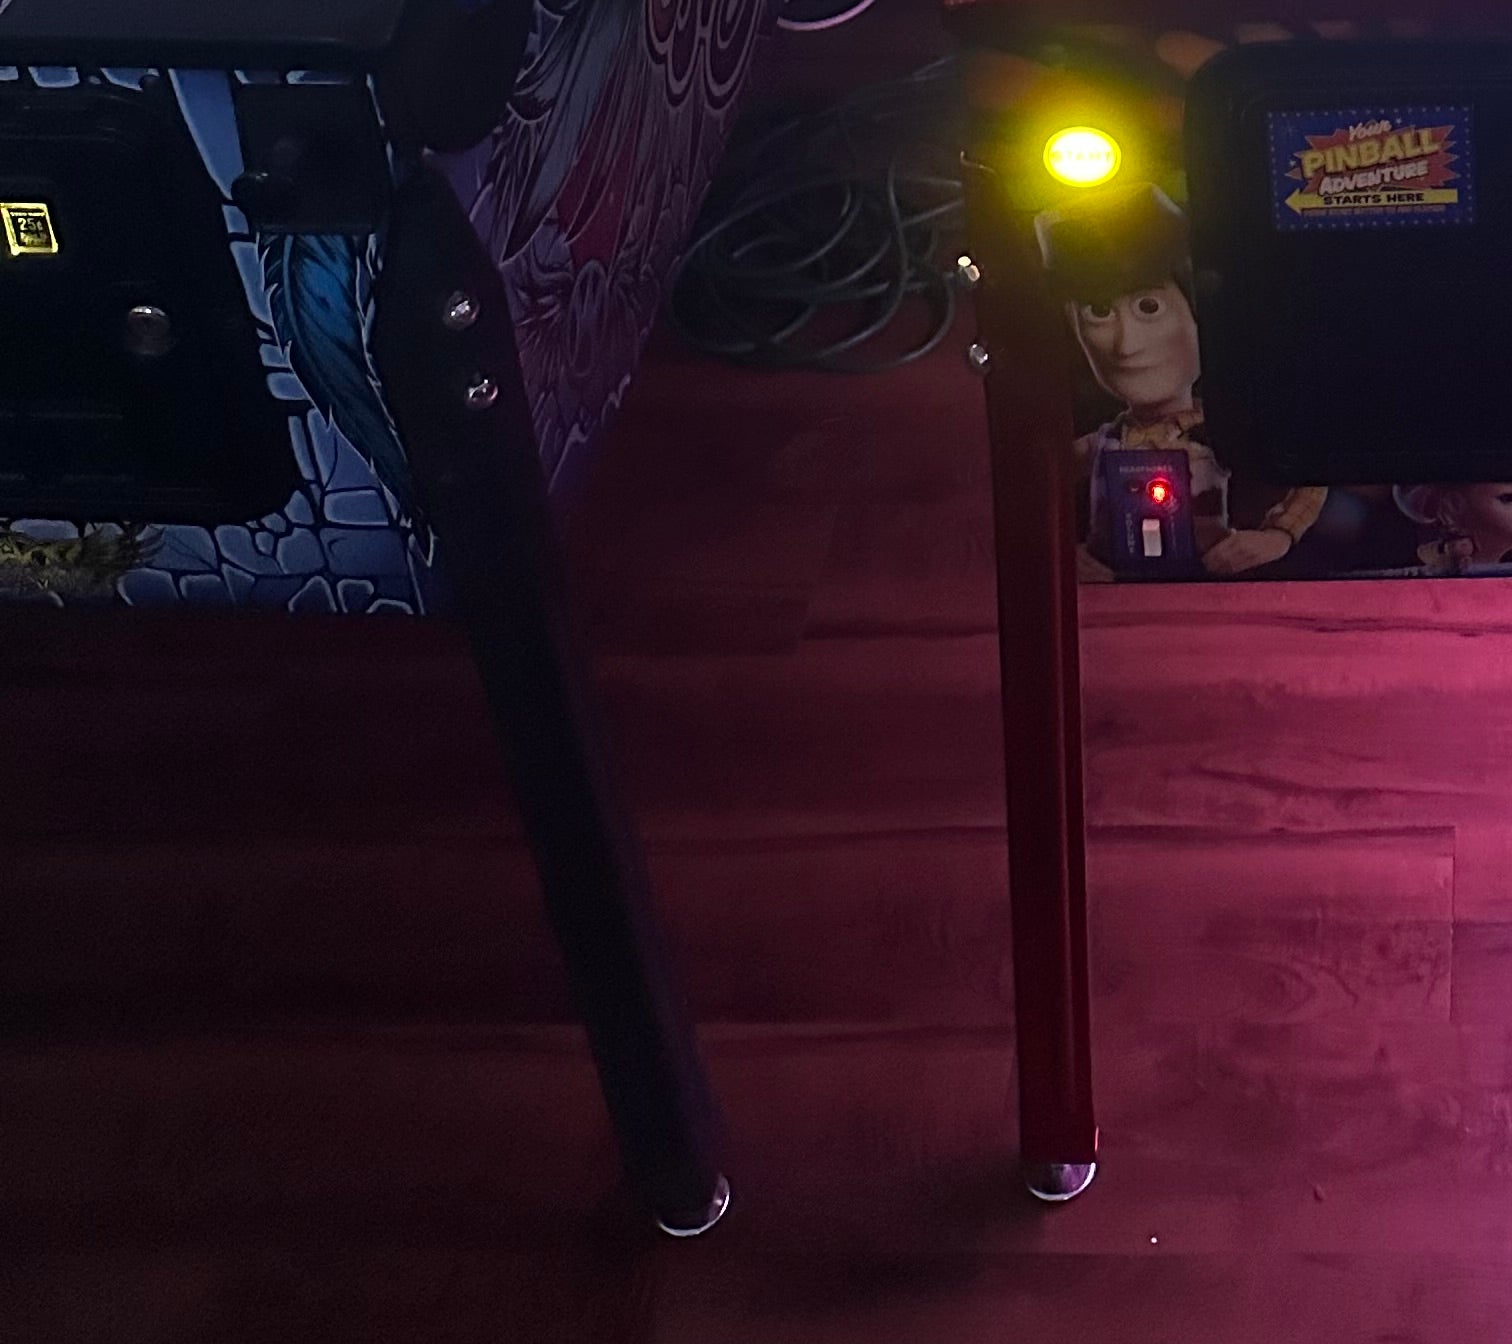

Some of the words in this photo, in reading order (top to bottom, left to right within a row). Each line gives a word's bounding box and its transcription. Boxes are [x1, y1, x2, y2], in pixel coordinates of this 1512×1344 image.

[1349, 118, 1393, 142] Your
[1301, 128, 1440, 178] PINBALL
[1318, 160, 1430, 196] ADVENTURE
[1323, 193, 1382, 206] STARTS
[1386, 192, 1425, 203] HERE
[17, 216, 44, 232] 25¢
